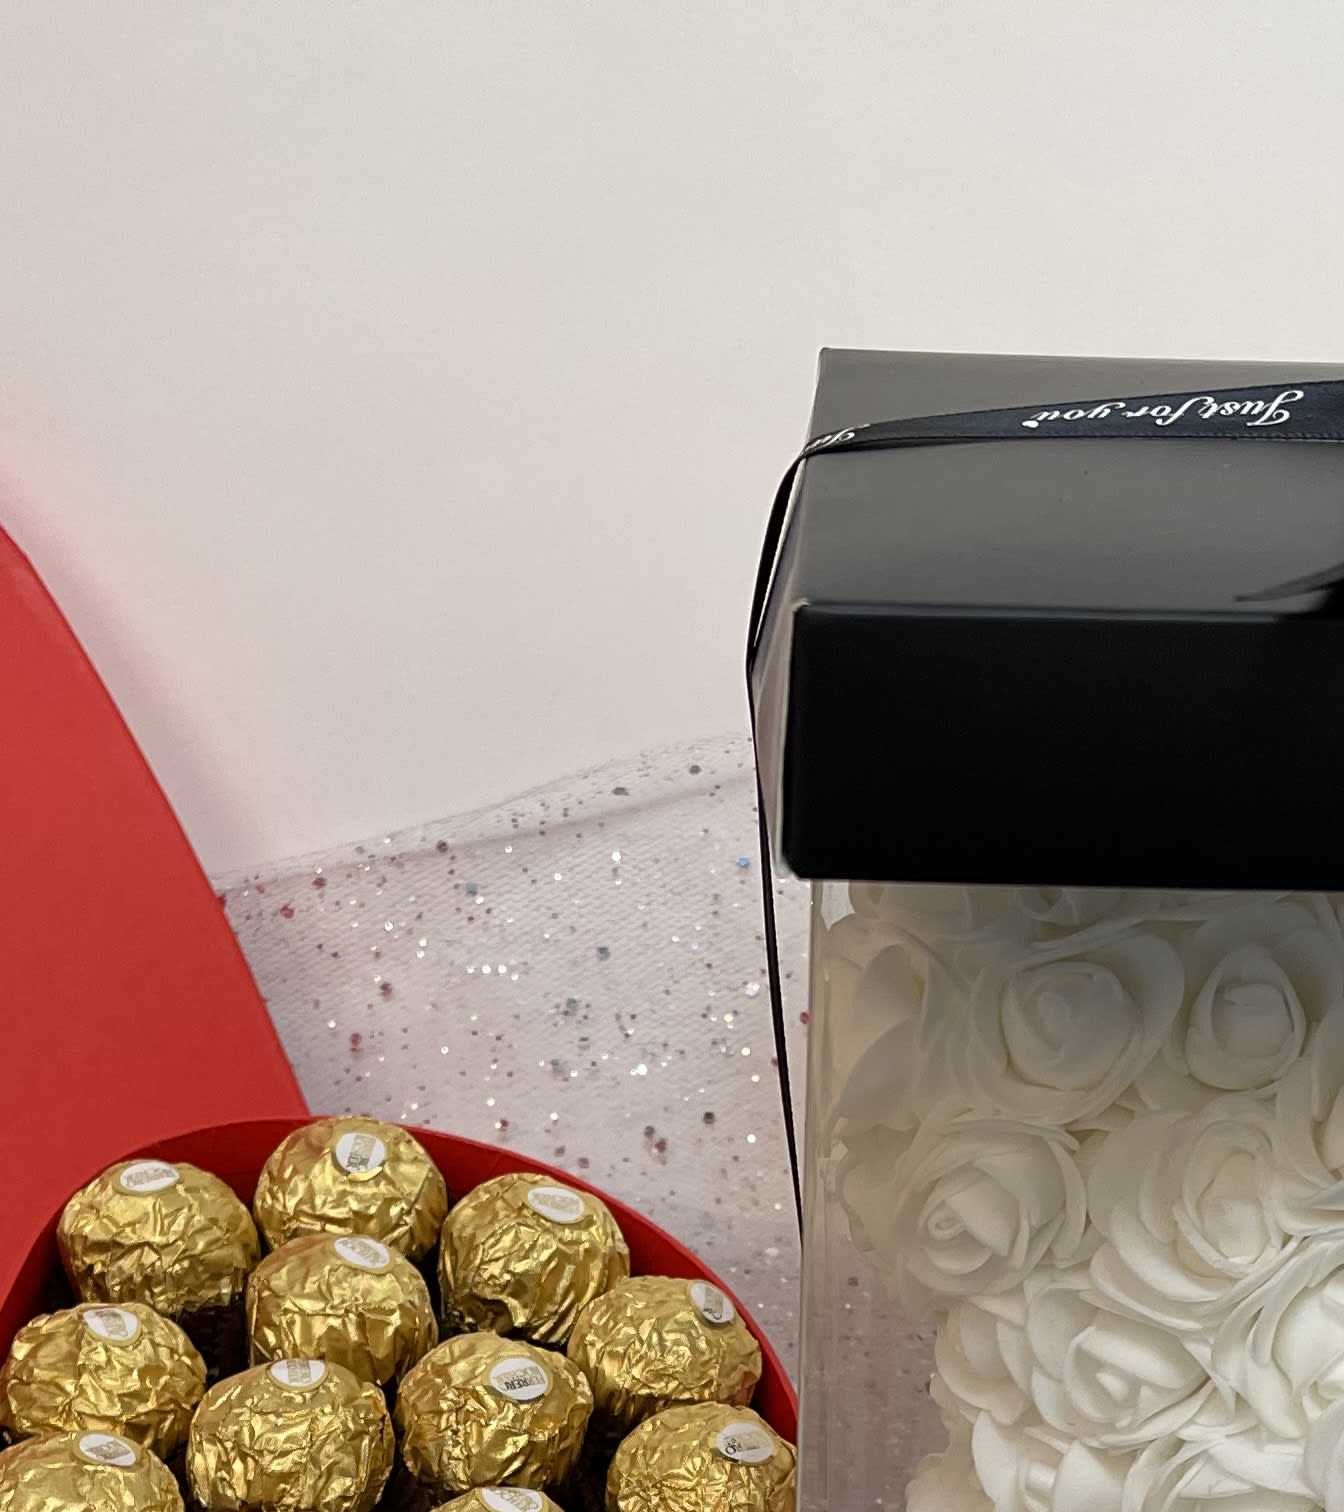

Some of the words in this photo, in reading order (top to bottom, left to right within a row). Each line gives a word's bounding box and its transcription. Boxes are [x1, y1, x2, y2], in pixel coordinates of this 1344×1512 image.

[1034, 401, 1127, 421] you
[1122, 396, 1216, 426] for
[1199, 389, 1305, 427] Just
